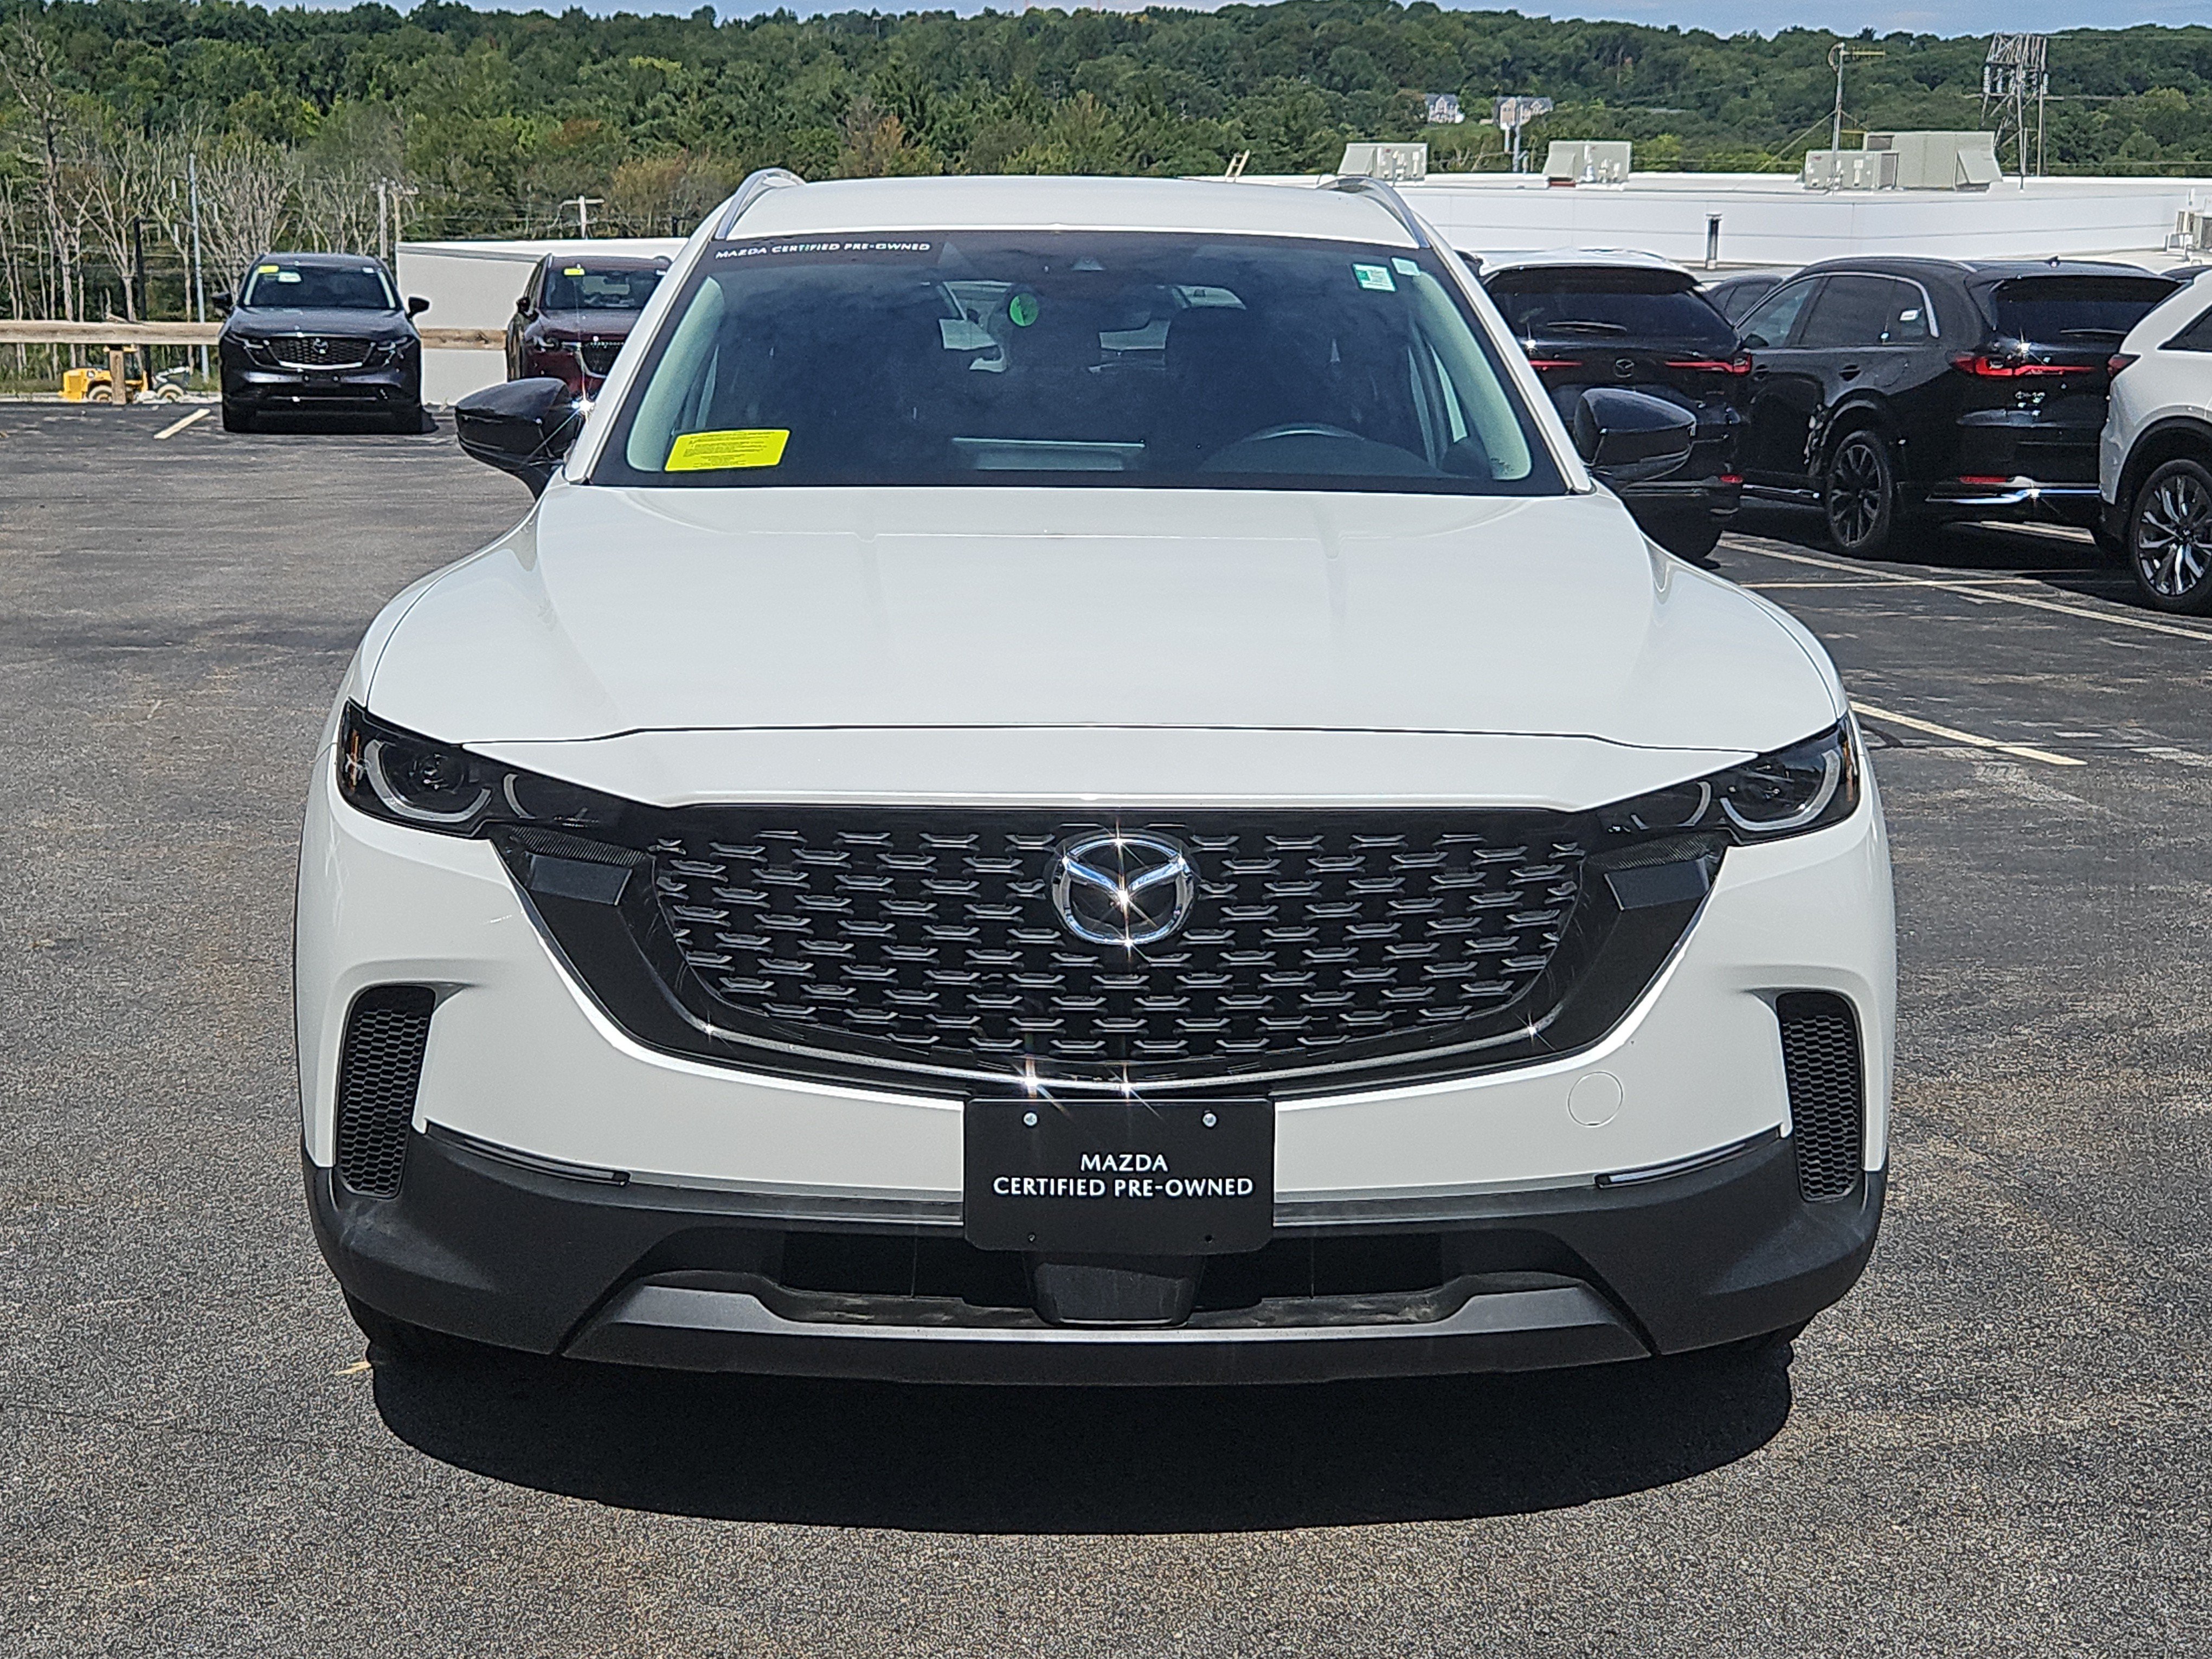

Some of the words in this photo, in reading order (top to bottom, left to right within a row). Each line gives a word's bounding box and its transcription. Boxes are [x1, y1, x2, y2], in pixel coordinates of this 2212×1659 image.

[715, 247, 767, 259] MAZDA
[771, 243, 840, 253] CERTIFIED
[844, 243, 931, 251] PRE-OWNED
[1080, 1154, 1168, 1172] MAZDA
[993, 1176, 1106, 1197] CERTIFIED
[1114, 1178, 1253, 1197] PRE-OWNED
